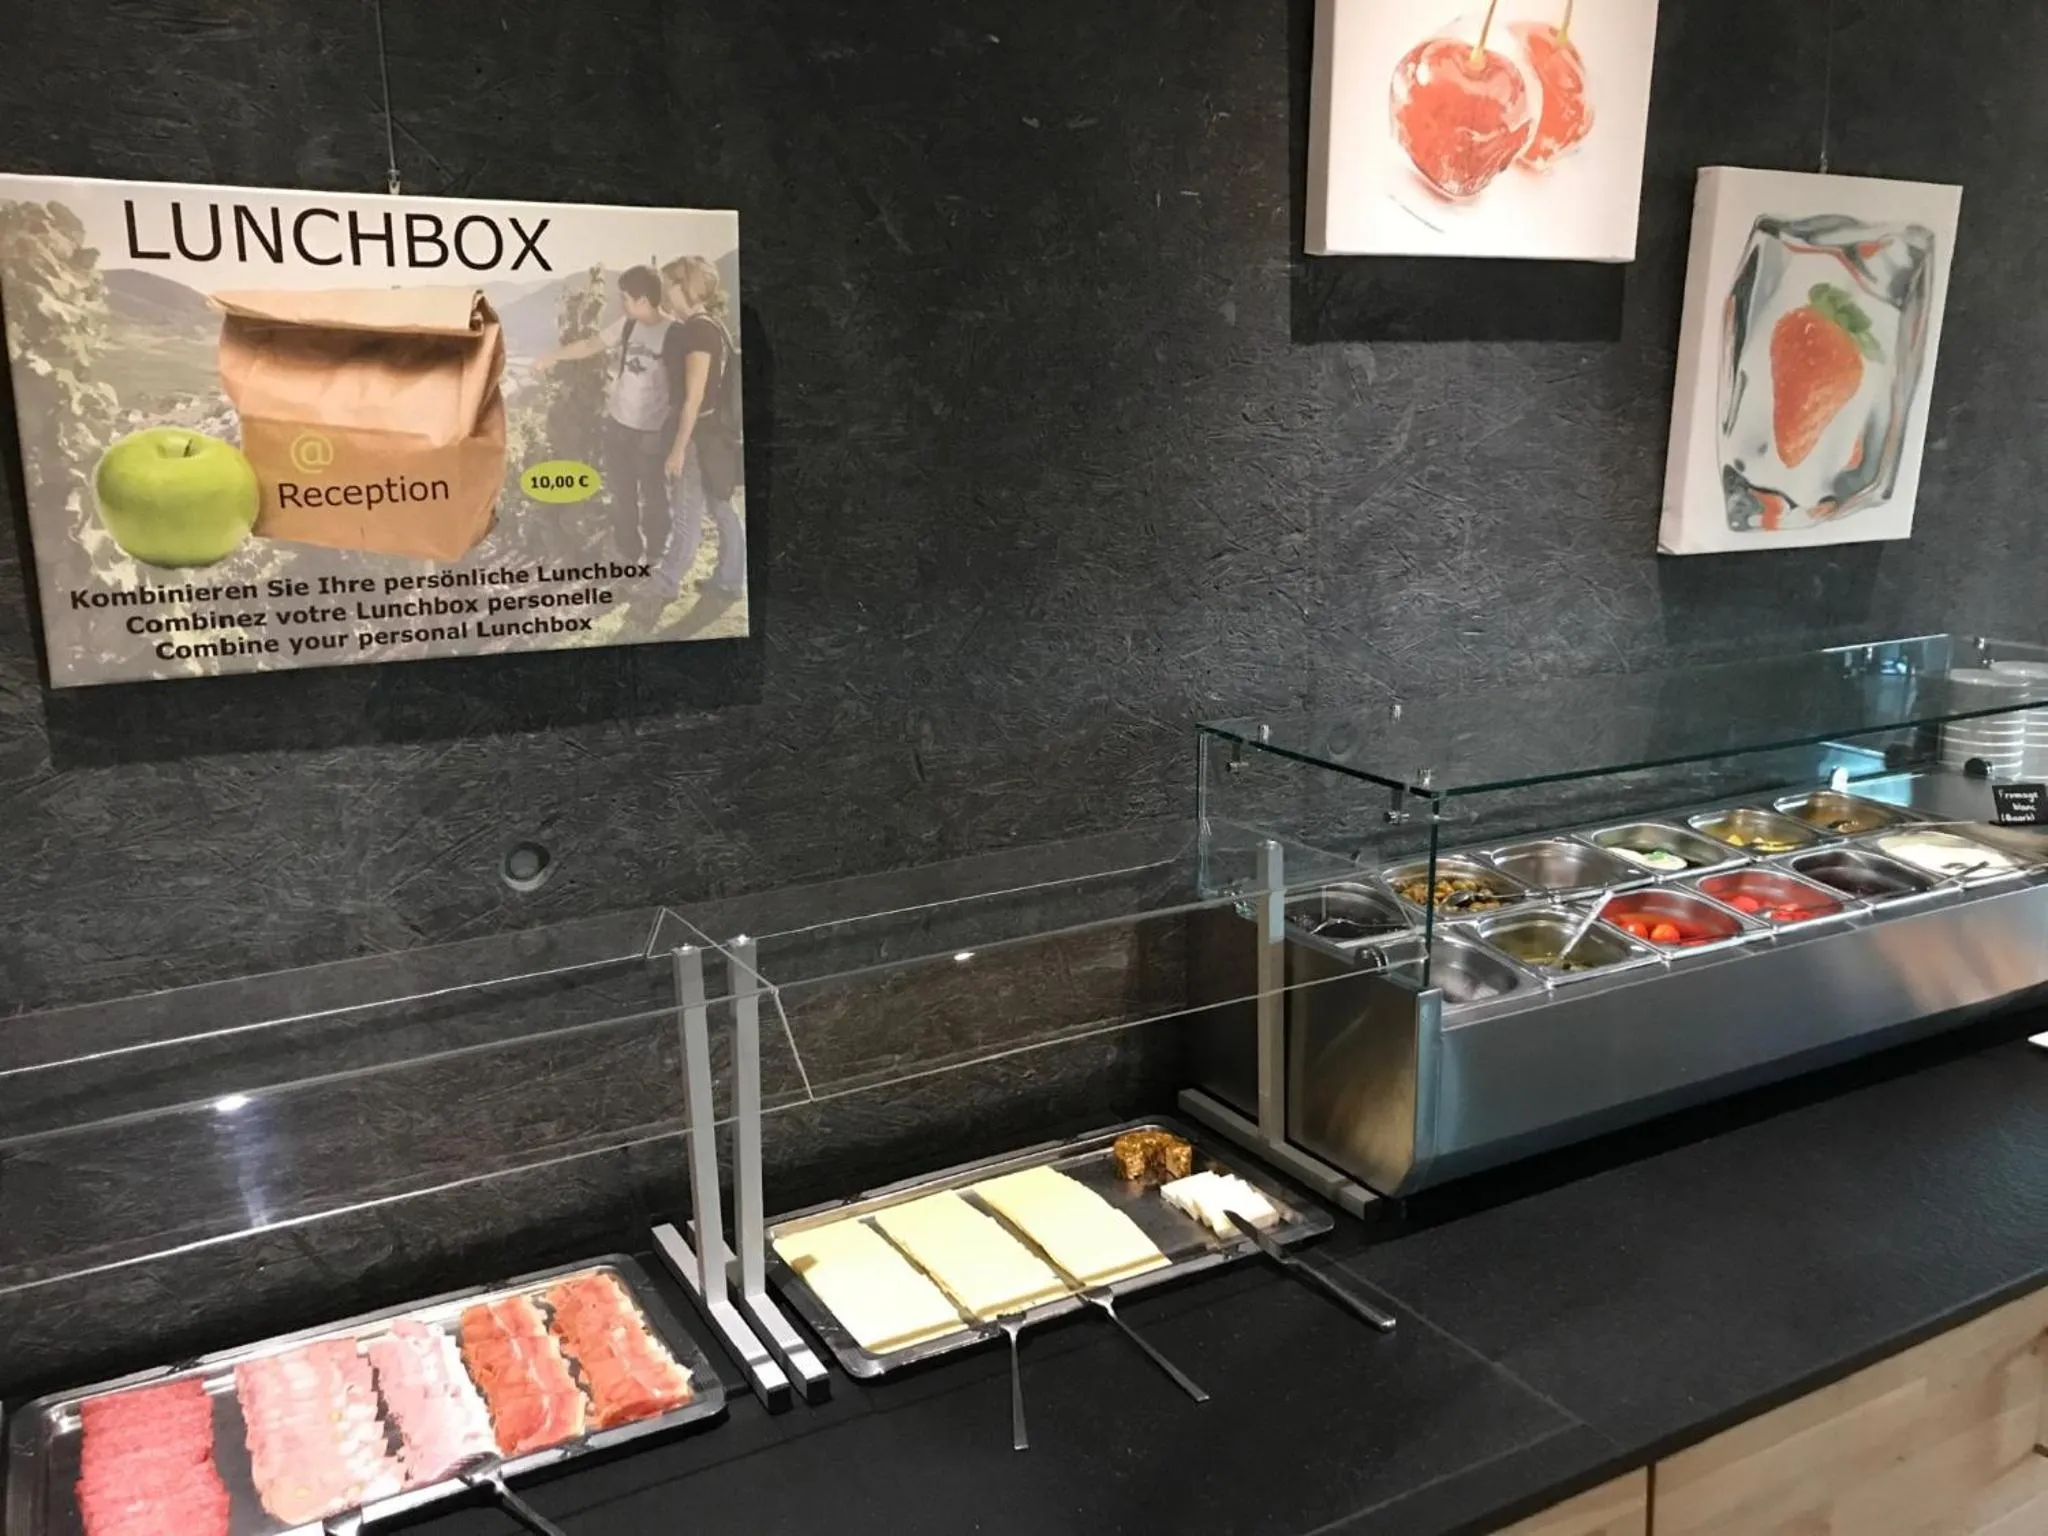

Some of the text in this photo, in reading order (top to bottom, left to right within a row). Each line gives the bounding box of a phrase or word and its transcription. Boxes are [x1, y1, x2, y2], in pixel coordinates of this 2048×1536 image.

[124, 200, 553, 271] LUNCHBOX
[291, 431, 334, 473] @
[278, 477, 449, 510] Reception
[530, 474, 590, 492] 10,00 €
[71, 561, 651, 610] Kombinieren Sie Ihre persönliche Lunchbox
[126, 587, 613, 635] Combinez votre Lunchbox personelle
[155, 615, 593, 661] Combine your personal Lunchbox
